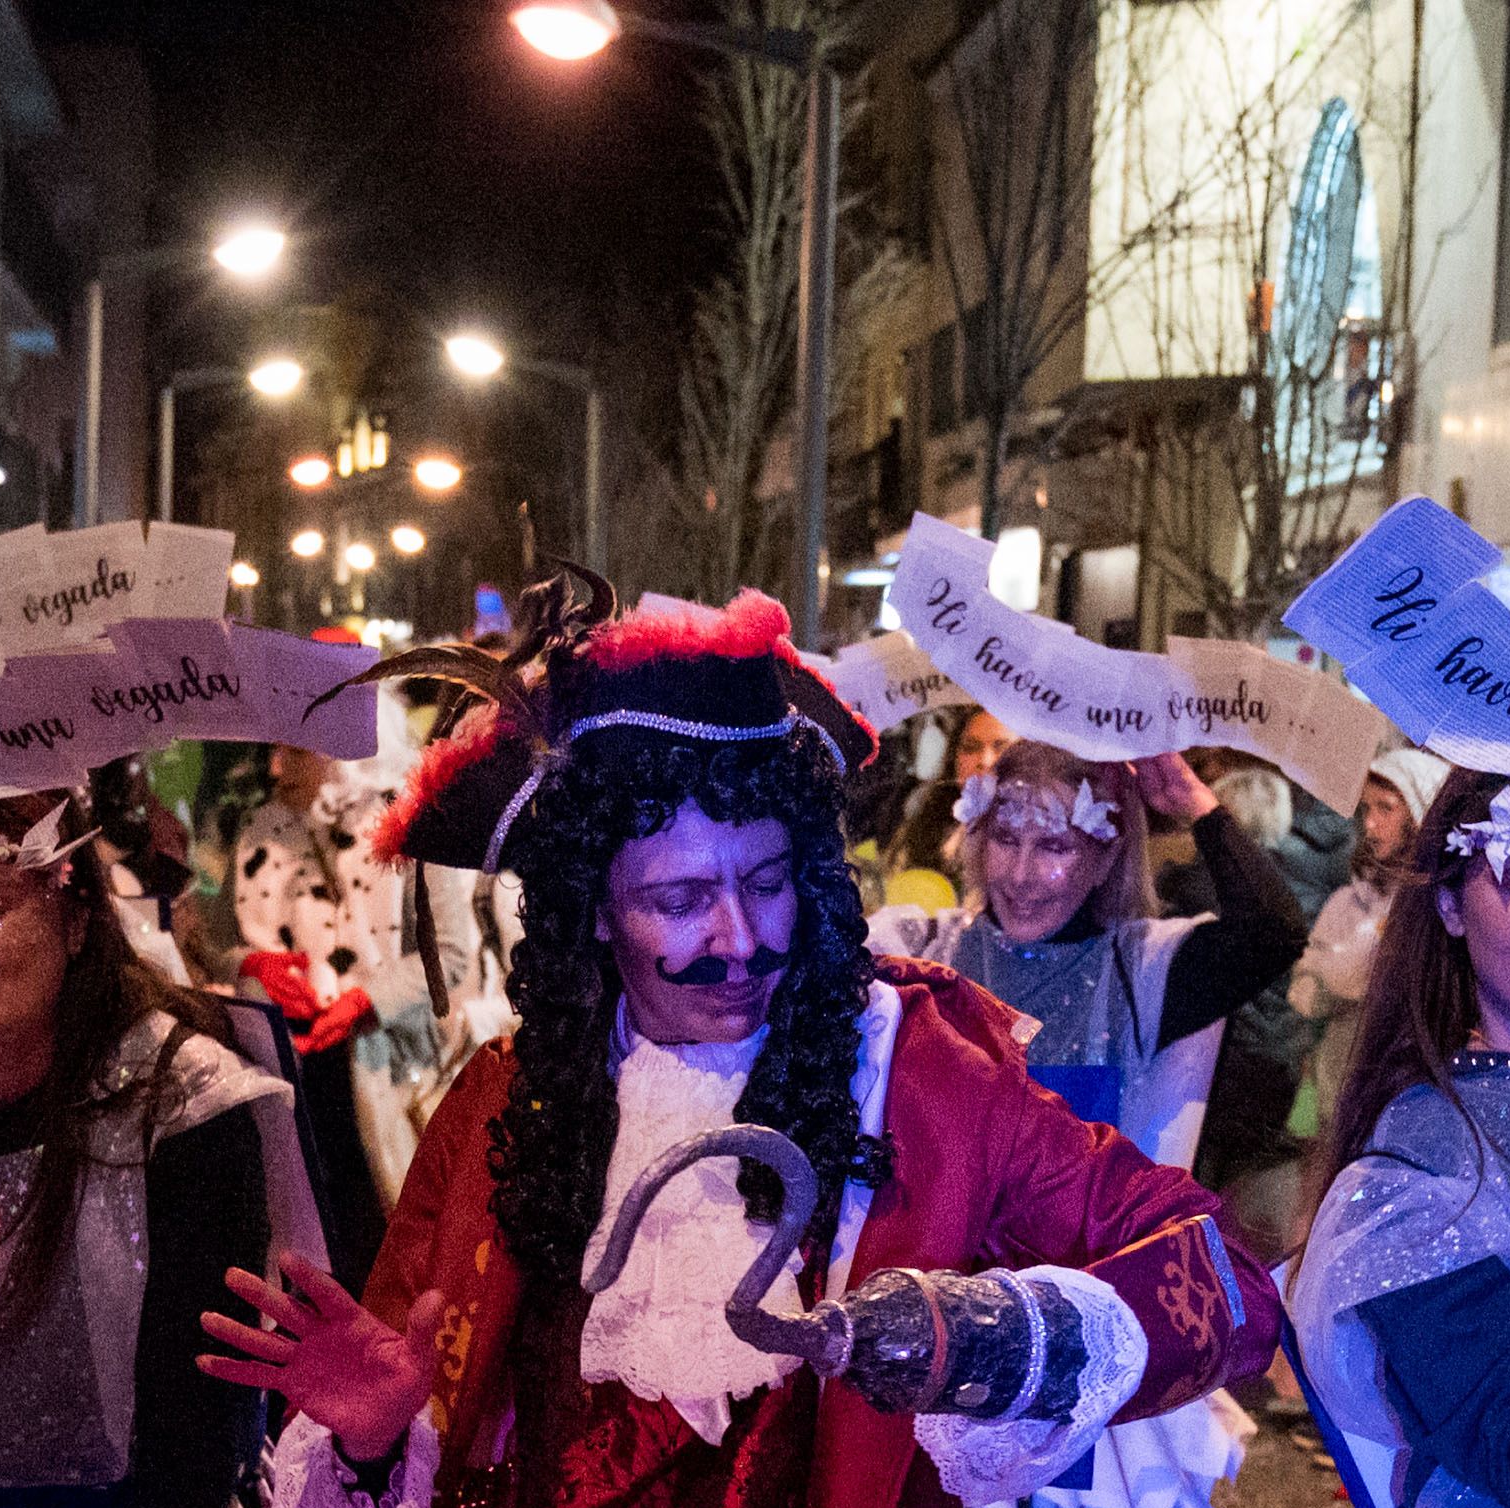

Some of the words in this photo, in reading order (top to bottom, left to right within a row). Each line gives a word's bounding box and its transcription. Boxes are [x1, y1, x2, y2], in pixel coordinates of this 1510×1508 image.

[22, 557, 136, 626] vegada
[1370, 566, 1437, 641] Hi
[92, 656, 240, 724] vegada
[885, 673, 952, 706] vega
[926, 577, 968, 635] Hi
[974, 636, 1070, 713] havia
[1087, 704, 1153, 734] una
[1168, 679, 1272, 734] vegada
